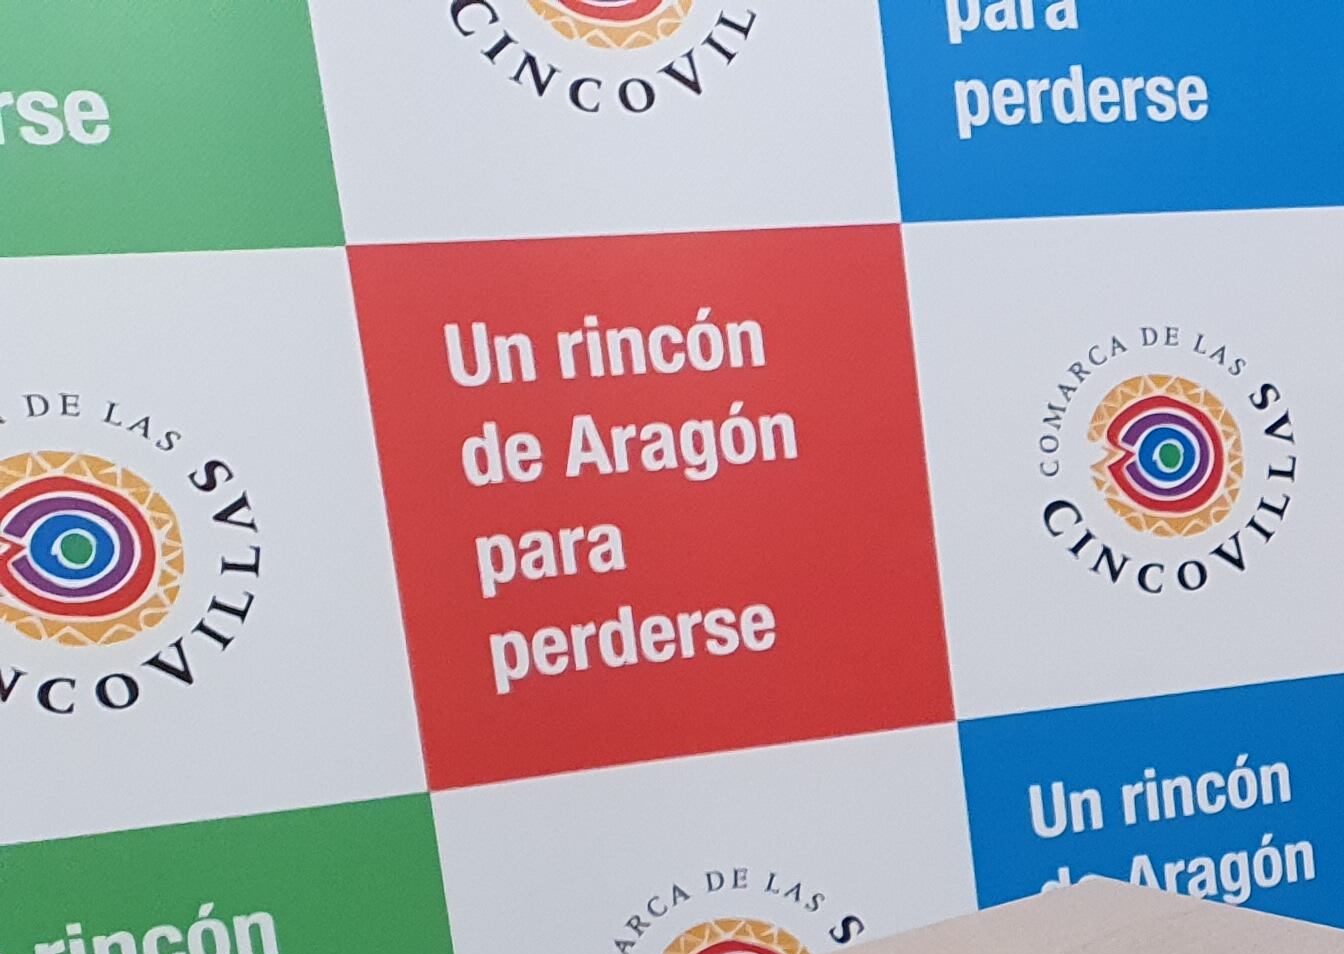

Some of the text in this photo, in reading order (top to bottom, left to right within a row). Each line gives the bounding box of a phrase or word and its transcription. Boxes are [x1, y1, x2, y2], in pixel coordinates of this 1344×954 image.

[450, 0, 757, 113] CINCOVIL
[954, 64, 1209, 139] perderse
[443, 307, 767, 387] Un rincón
[23, 393, 182, 451] DE LAS
[1040, 327, 1247, 476] COMARCA DE LAS
[461, 402, 798, 487] de Aragón
[475, 523, 627, 599] para
[489, 603, 777, 694] perderse
[1029, 753, 1292, 838] Un rincón
[705, 867, 748, 889] DE
[764, 872, 825, 912] LAS
[1130, 833, 1316, 906] Aragón
